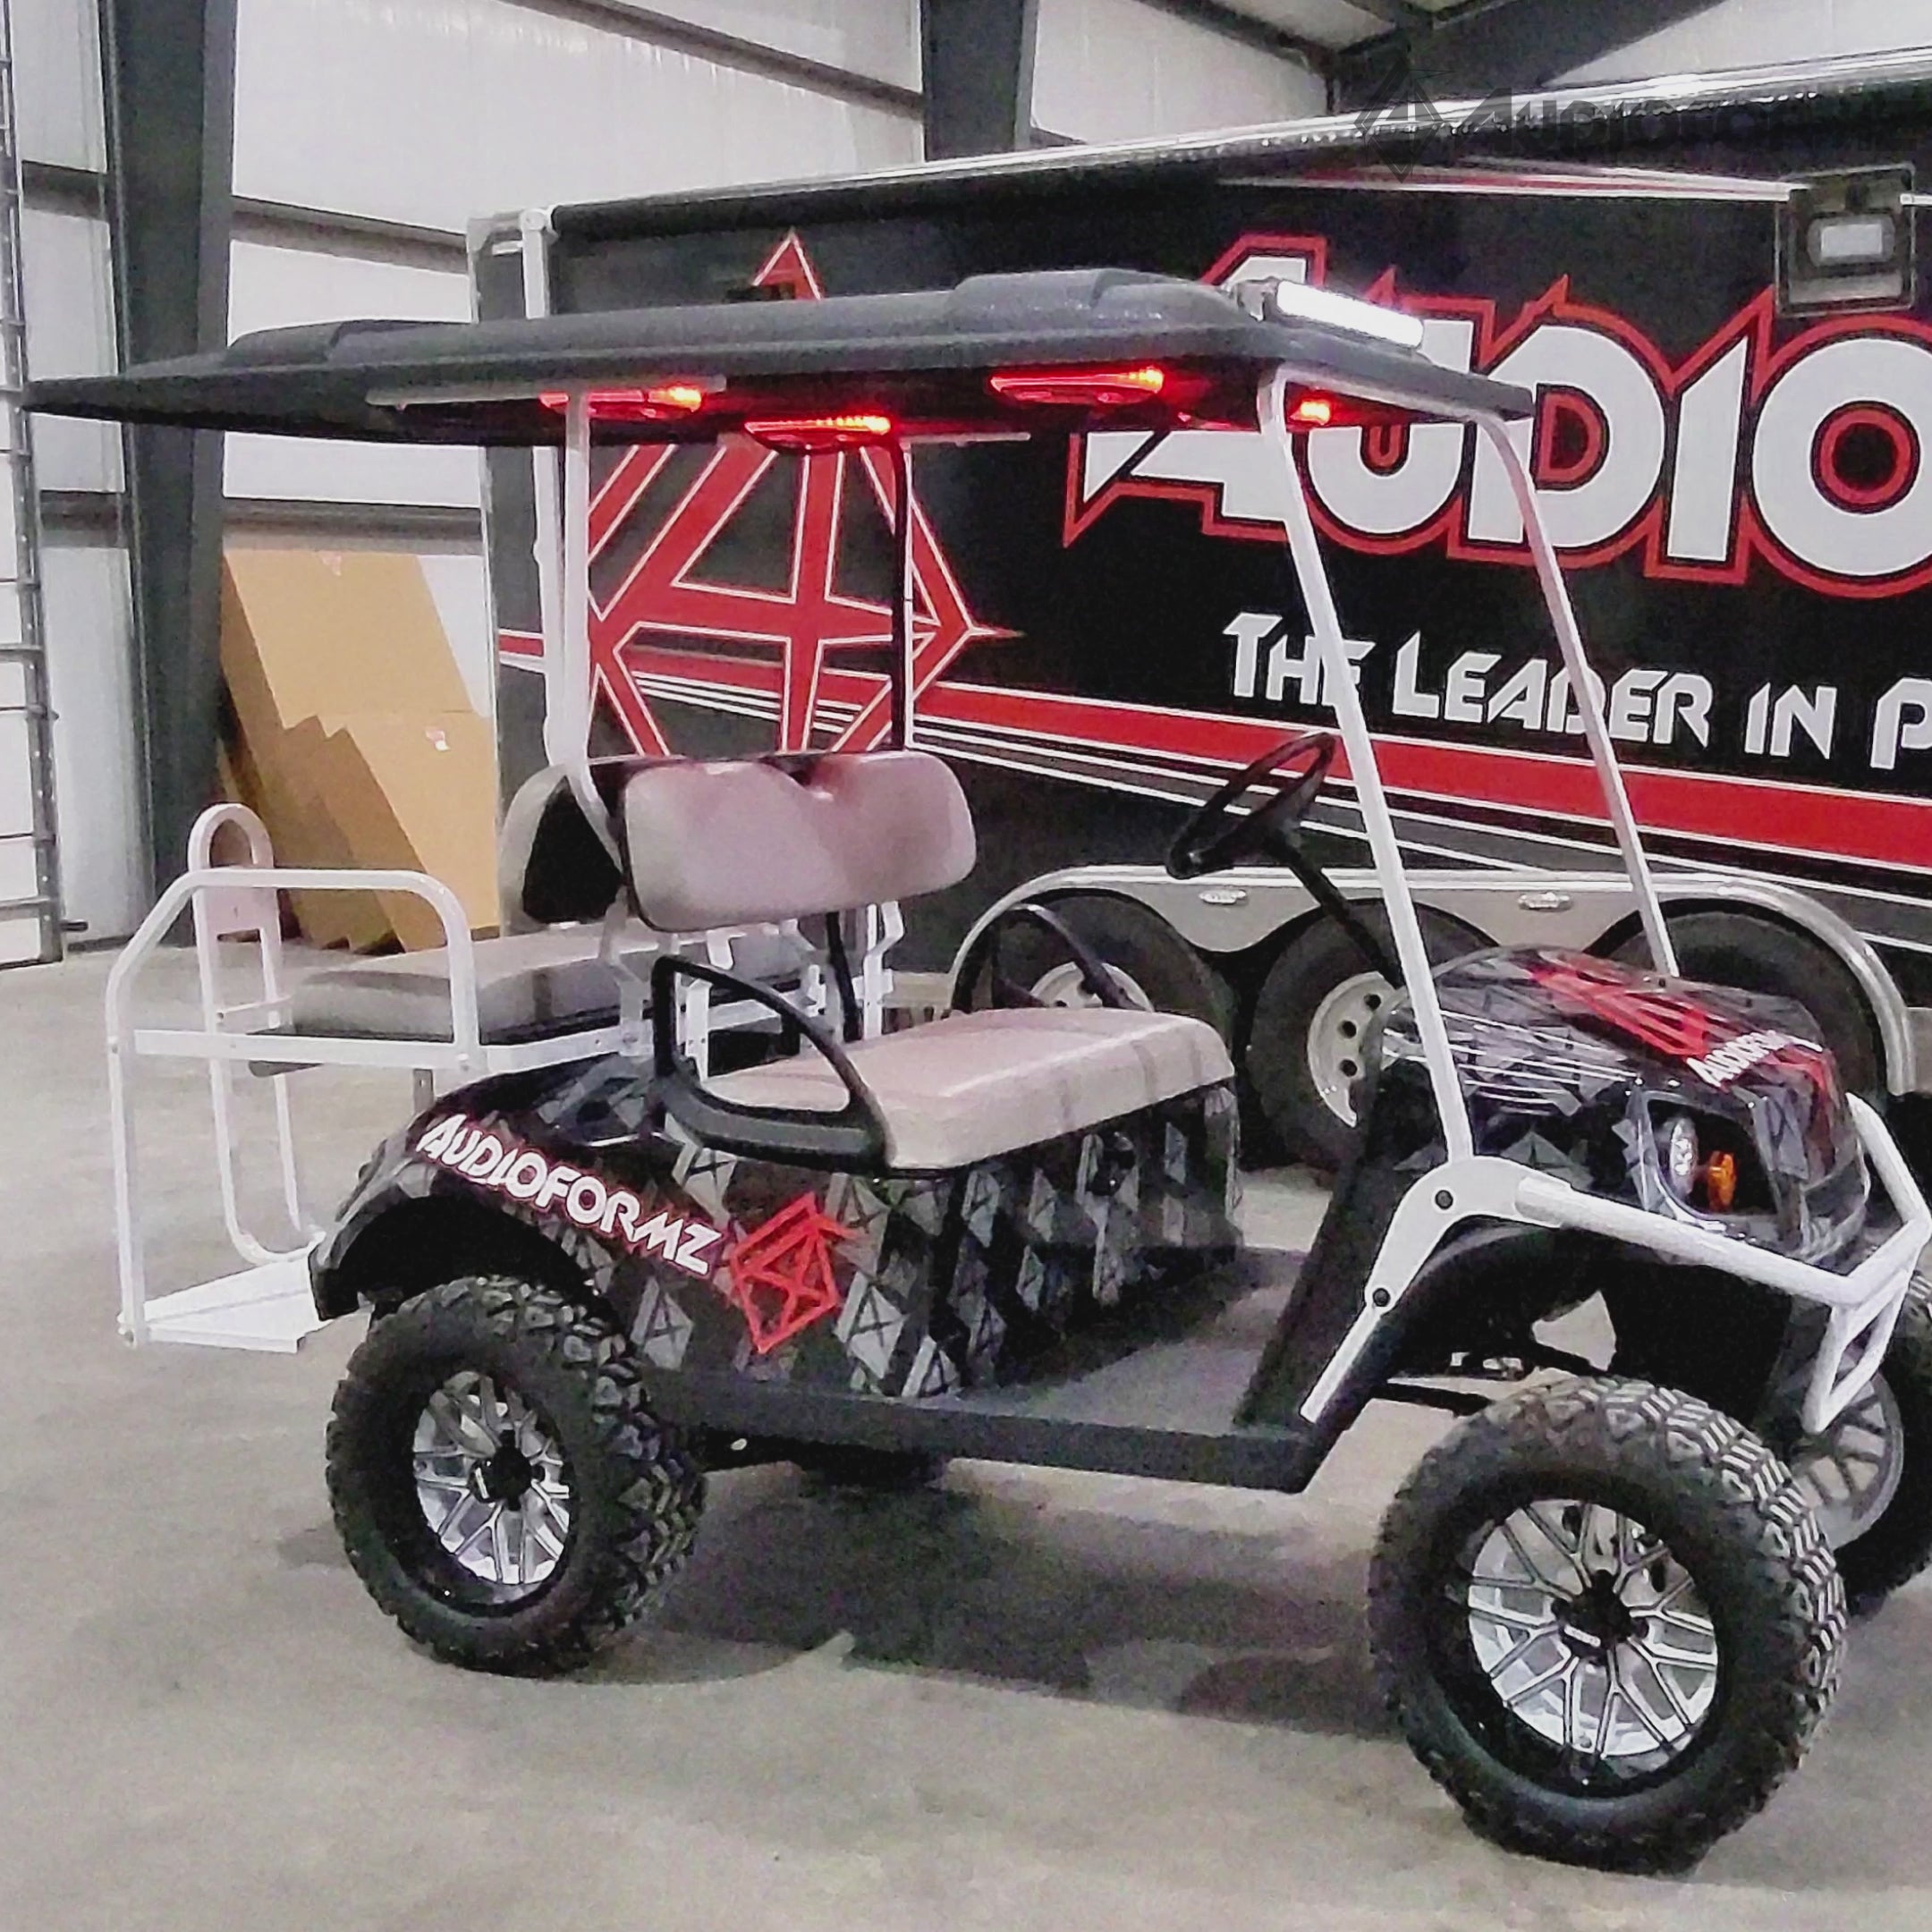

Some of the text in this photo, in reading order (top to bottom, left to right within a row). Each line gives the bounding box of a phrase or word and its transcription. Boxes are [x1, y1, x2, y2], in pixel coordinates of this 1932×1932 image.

[1392, 630, 1714, 749] LEADER
[1744, 681, 1838, 760] IN
[415, 1113, 723, 1275] AUDIOFORMZ
